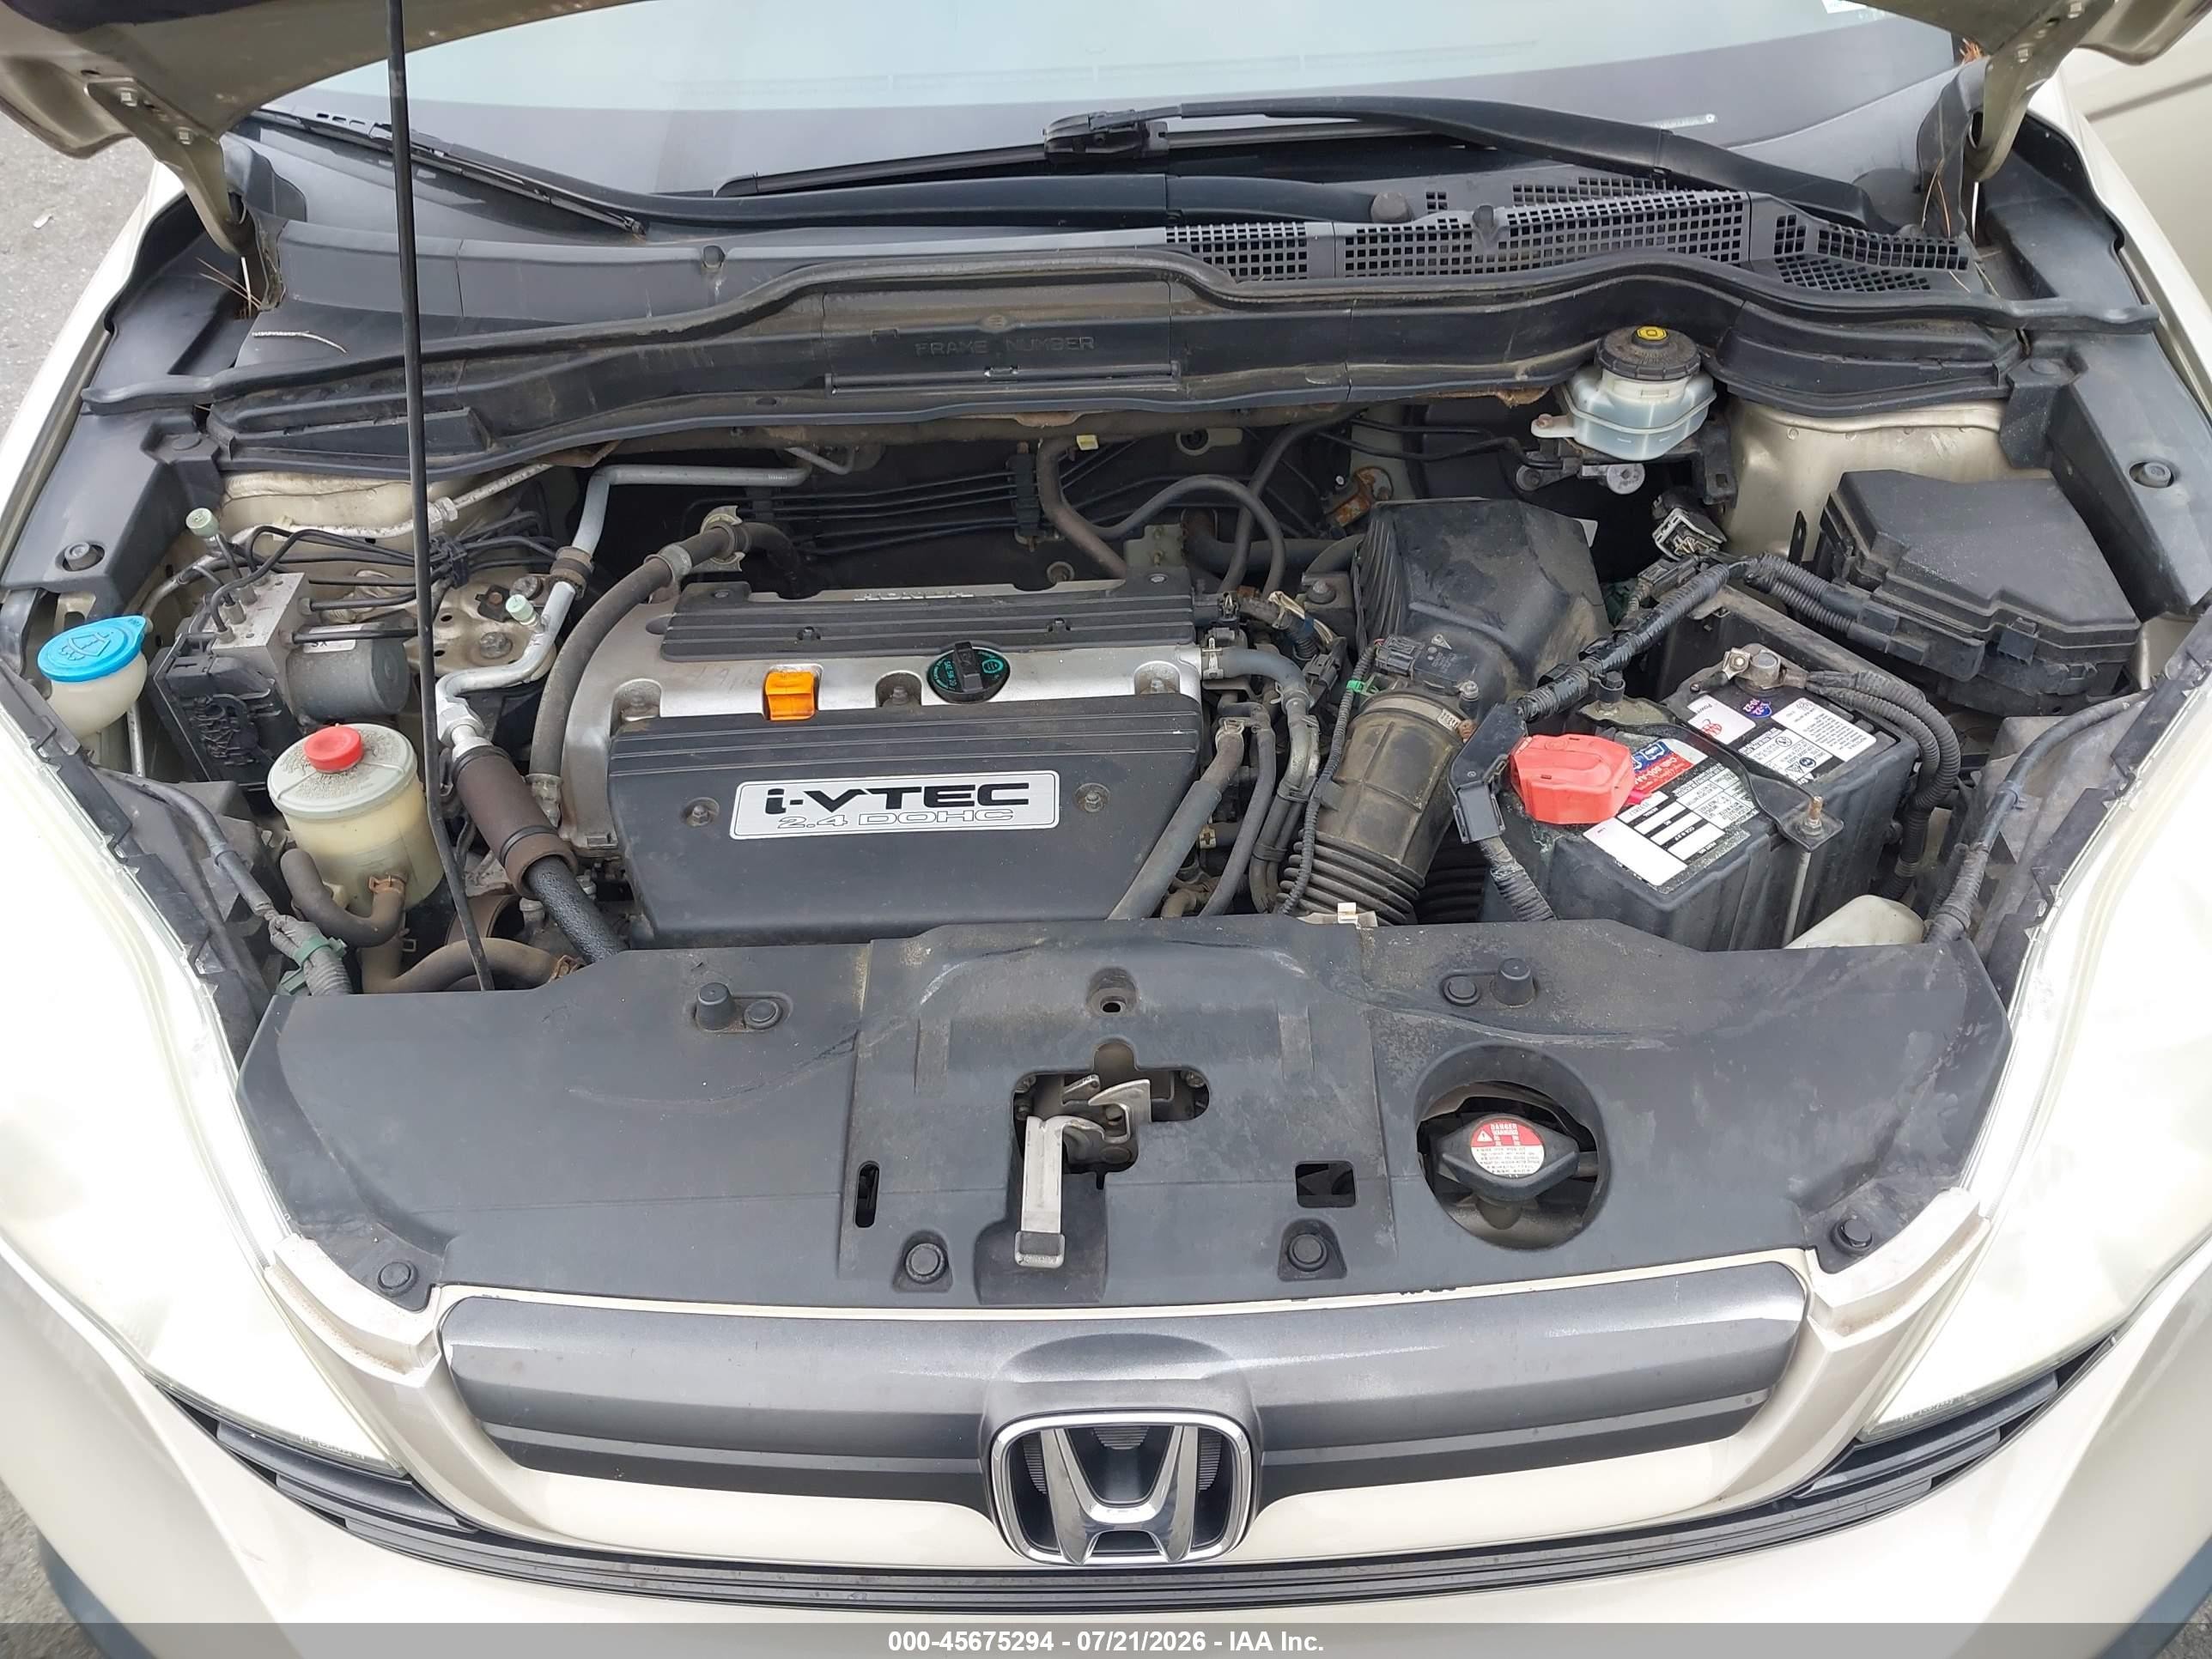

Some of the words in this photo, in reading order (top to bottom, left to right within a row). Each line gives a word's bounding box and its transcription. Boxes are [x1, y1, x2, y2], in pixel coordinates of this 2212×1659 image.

[915, 340, 989, 357] FRAME
[1005, 336, 1096, 352] NUMBER
[765, 782, 1030, 814] i-VTEC
[777, 814, 848, 830] 2.4
[858, 809, 1013, 825] DOHC
